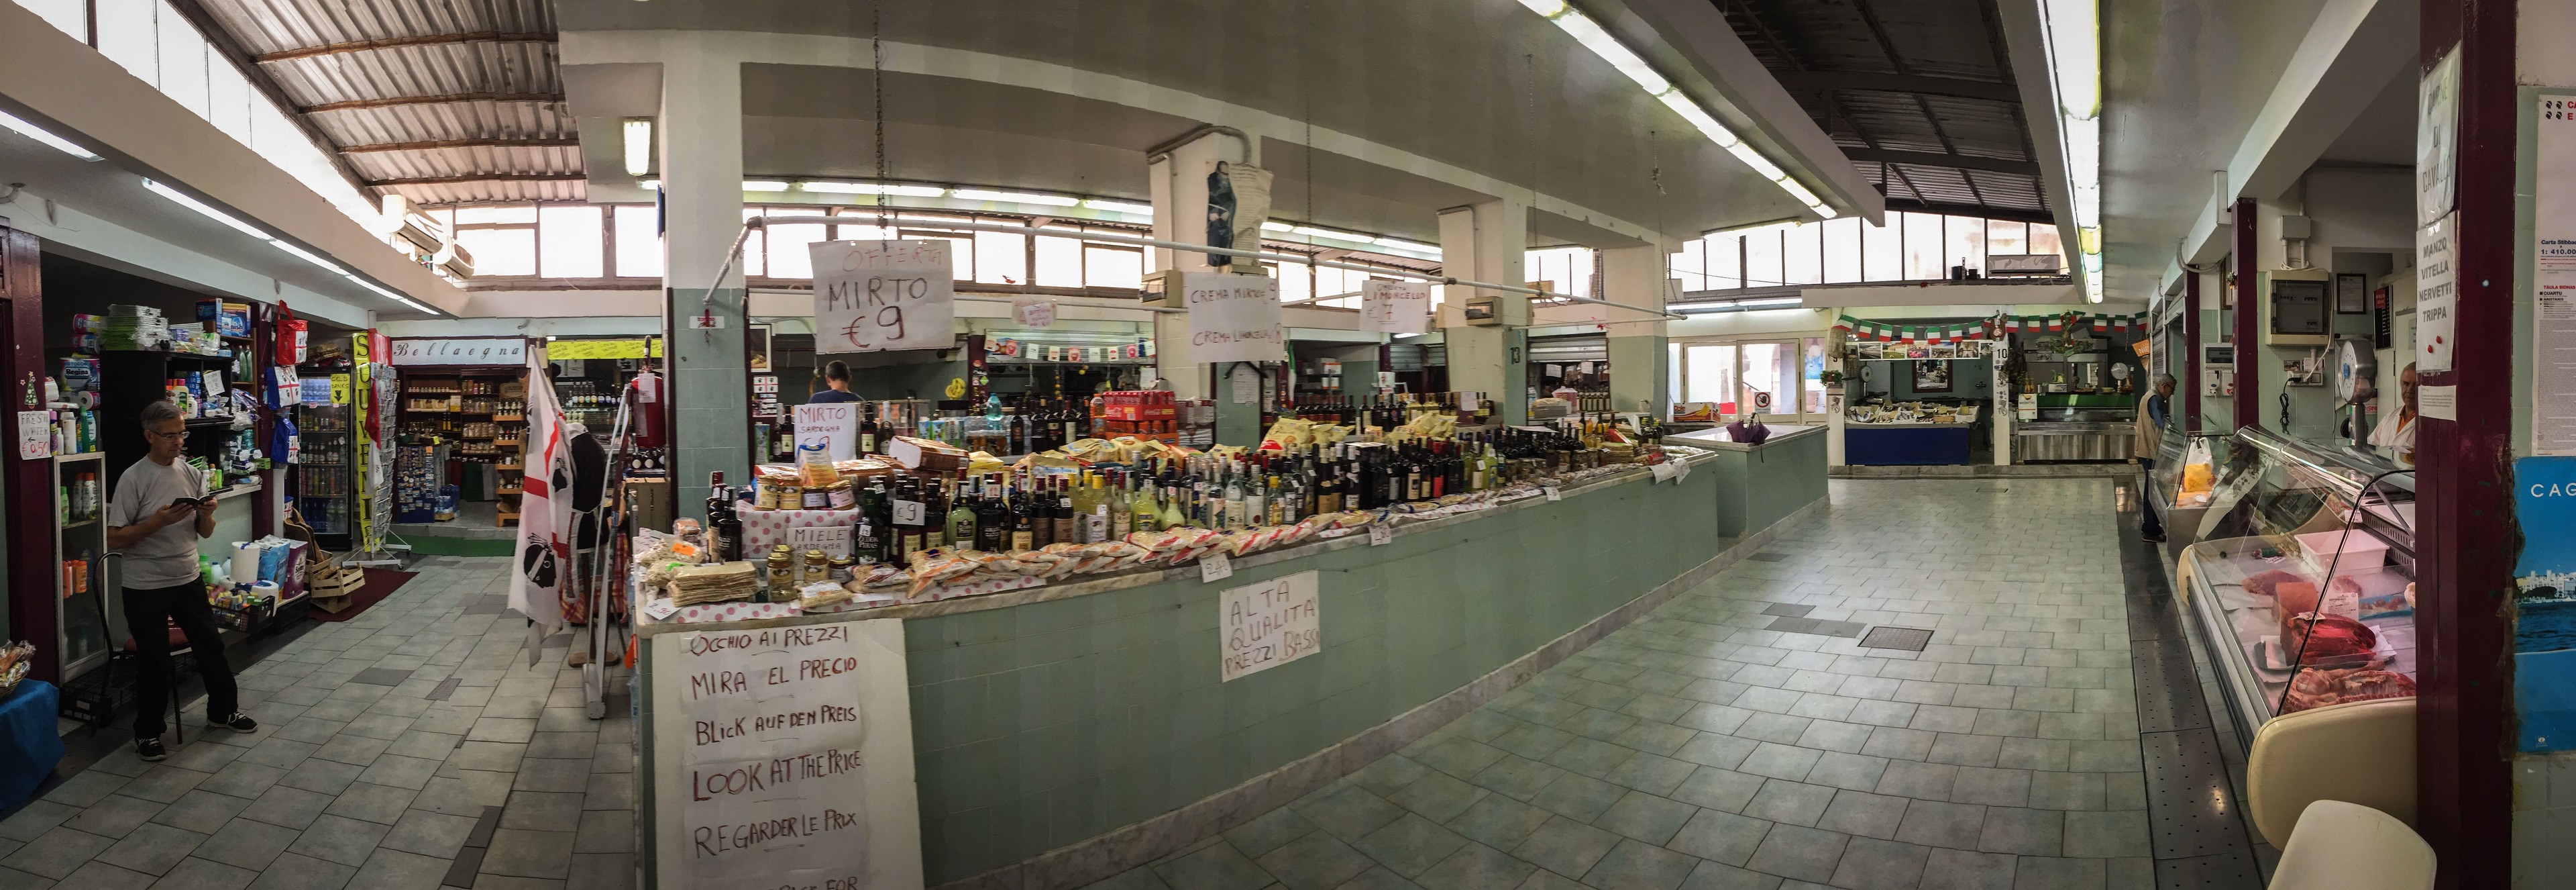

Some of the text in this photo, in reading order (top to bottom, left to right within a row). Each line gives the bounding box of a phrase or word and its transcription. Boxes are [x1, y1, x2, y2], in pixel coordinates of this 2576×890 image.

[2433, 123, 2440, 148] DI
[2422, 155, 2451, 193] CAVALLO
[842, 246, 942, 272] OFFERTA
[2423, 237, 2447, 259] MANZO
[2421, 260, 2449, 281] VITELLA
[828, 275, 928, 312] MIRTO
[1190, 290, 1229, 303] CREMA
[2419, 281, 2452, 302] NERVETTI
[2422, 306, 2447, 323] TRIPPA
[1510, 347, 1521, 364] 13
[1996, 349, 2008, 358] 10
[21, 413, 49, 425] FRESH
[799, 407, 847, 424] MIRTO
[21, 426, 49, 437] WATER
[798, 425, 841, 434] SARDEGNA
[795, 530, 847, 542] MIELE
[1230, 581, 1290, 626] ALTA
[690, 626, 848, 656] OCCHIO AI PREZZI
[1224, 644, 1277, 675] PREZZI
[691, 657, 857, 700] MIRA EL PRECIO
[755, 714, 786, 732] AUF
[789, 710, 816, 728] DEN
[820, 705, 857, 724] PREIS
[693, 749, 861, 801] LOOK AT THE PRICE
[694, 808, 858, 858] REGARDER LE PRIX
